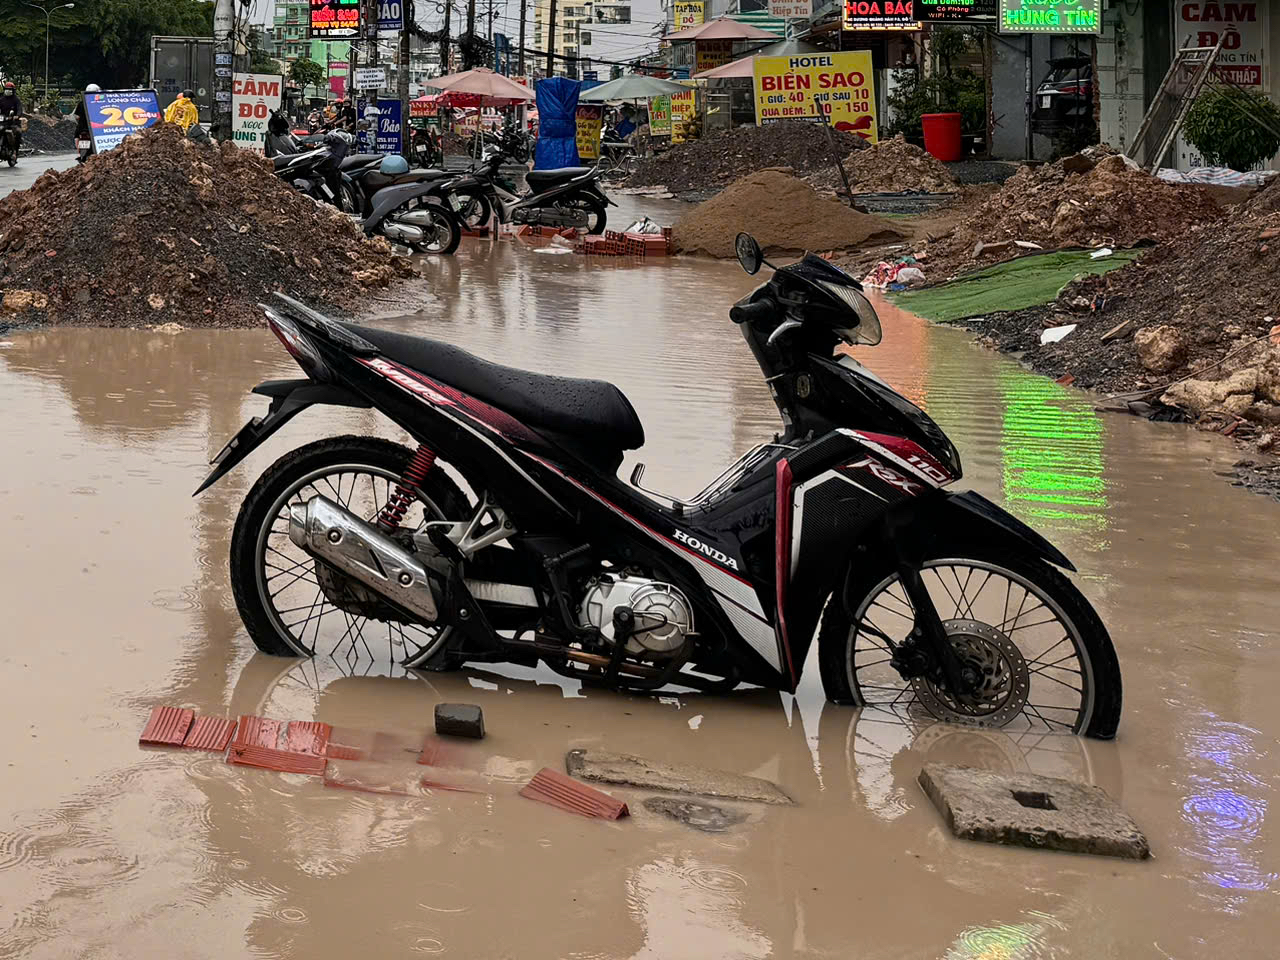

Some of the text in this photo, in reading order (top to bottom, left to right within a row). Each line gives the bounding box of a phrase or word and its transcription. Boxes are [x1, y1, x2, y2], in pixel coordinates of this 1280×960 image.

[337, 8, 359, 21] SAO
[772, 6, 792, 17] Hiệp
[847, 1, 881, 15] HOA
[1006, 5, 1096, 26] HÙNG TÍN
[1197, 24, 1241, 50] ĐỒ
[789, 56, 834, 68] HOTEL
[233, 74, 279, 97] CẦM
[761, 69, 865, 91] BIỂN SAO
[767, 94, 786, 104] GIỜ:
[788, 91, 805, 102] 40
[832, 91, 851, 100] SAU
[854, 88, 870, 100] 10
[238, 98, 268, 119] ĐỒ
[761, 108, 780, 117] QUA
[782, 105, 807, 116] ĐÊM:
[809, 103, 832, 115] 10
[846, 101, 869, 113] 150
[242, 120, 264, 130] NGỌC
[907, 454, 948, 482] 110
[672, 527, 739, 572] HONDA
